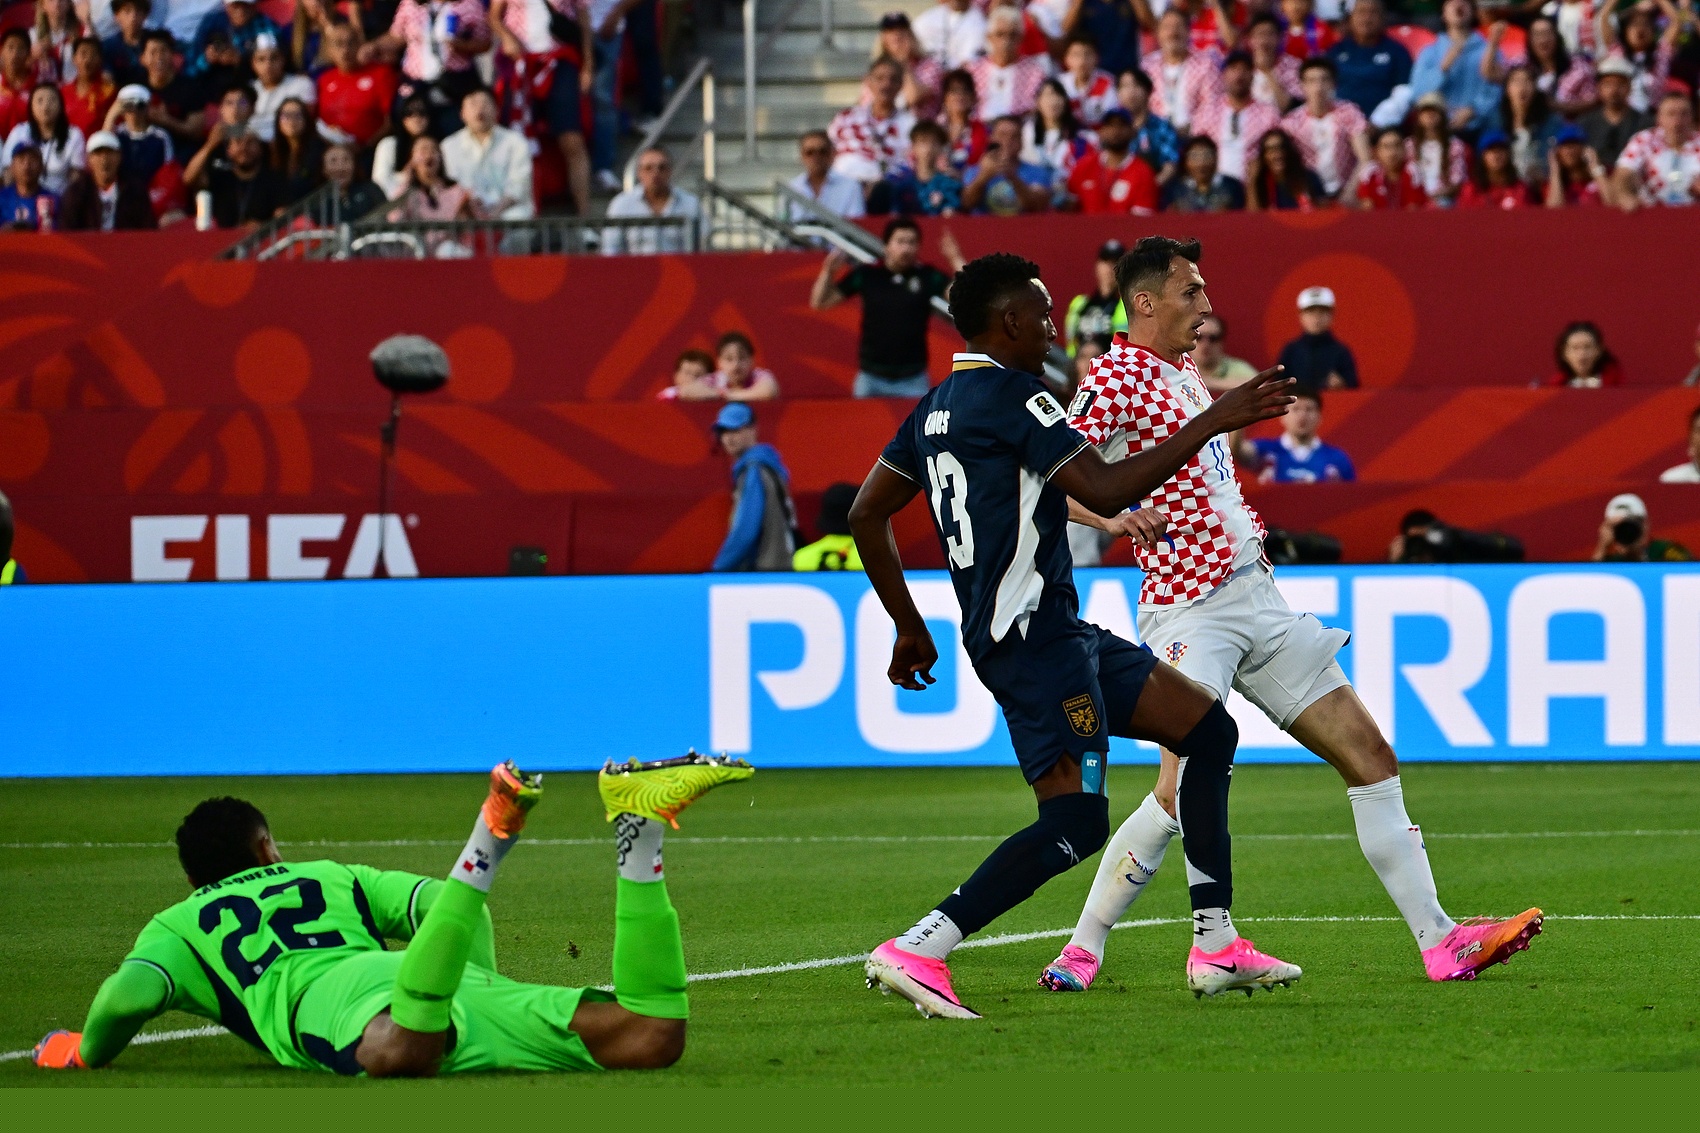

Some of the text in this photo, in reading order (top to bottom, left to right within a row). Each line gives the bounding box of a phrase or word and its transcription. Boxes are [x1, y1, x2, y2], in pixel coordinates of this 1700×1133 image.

[1209, 440, 1231, 482] 11
[926, 451, 975, 572] 13
[131, 513, 420, 582] FIFA
[1065, 696, 1089, 709] PANAMA
[198, 877, 348, 992] 22
